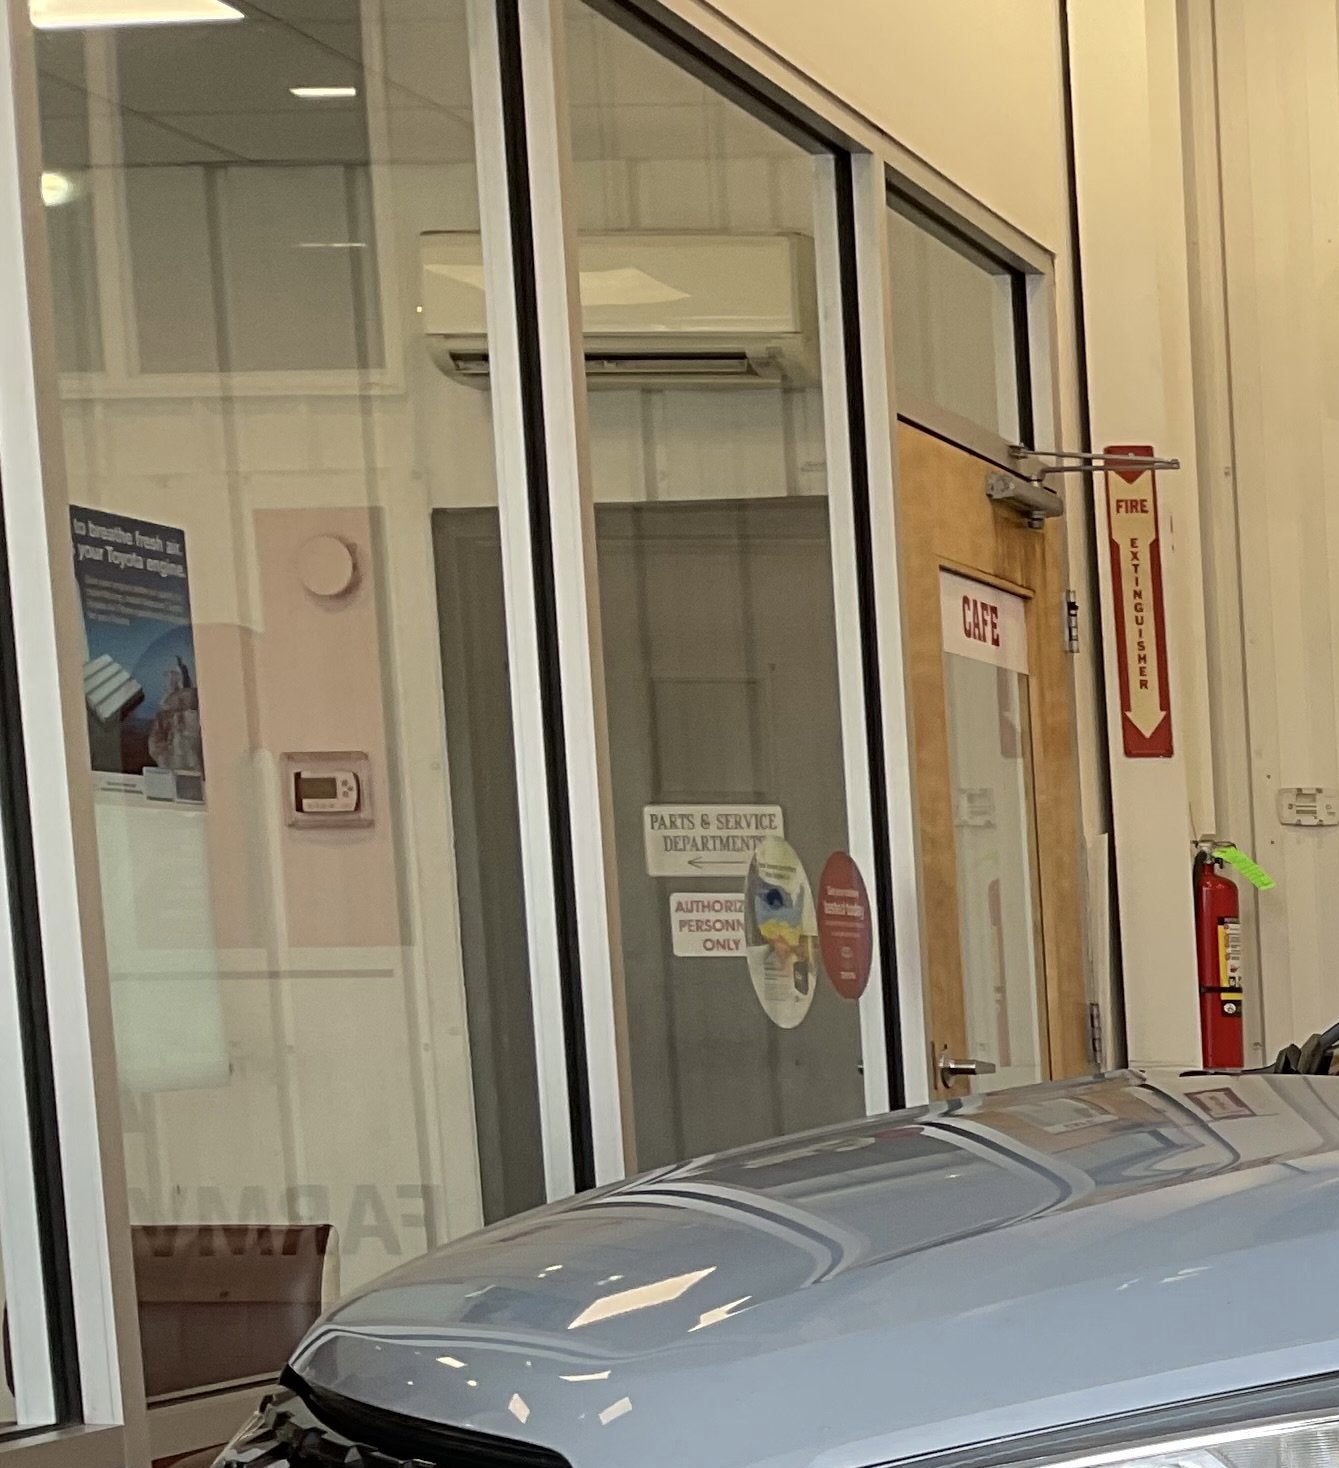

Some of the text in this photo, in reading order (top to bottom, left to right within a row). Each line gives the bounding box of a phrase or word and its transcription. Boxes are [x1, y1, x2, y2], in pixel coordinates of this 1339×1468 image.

[1116, 499, 1149, 514] FIRE
[135, 530, 164, 552] fresh
[105, 545, 144, 569] Toyota
[962, 595, 1000, 647] CAFE
[1129, 537, 1149, 690] EXTINGUISHER
[649, 813, 778, 830] PARTS & SERVICE
[702, 938, 741, 951] ONLY
